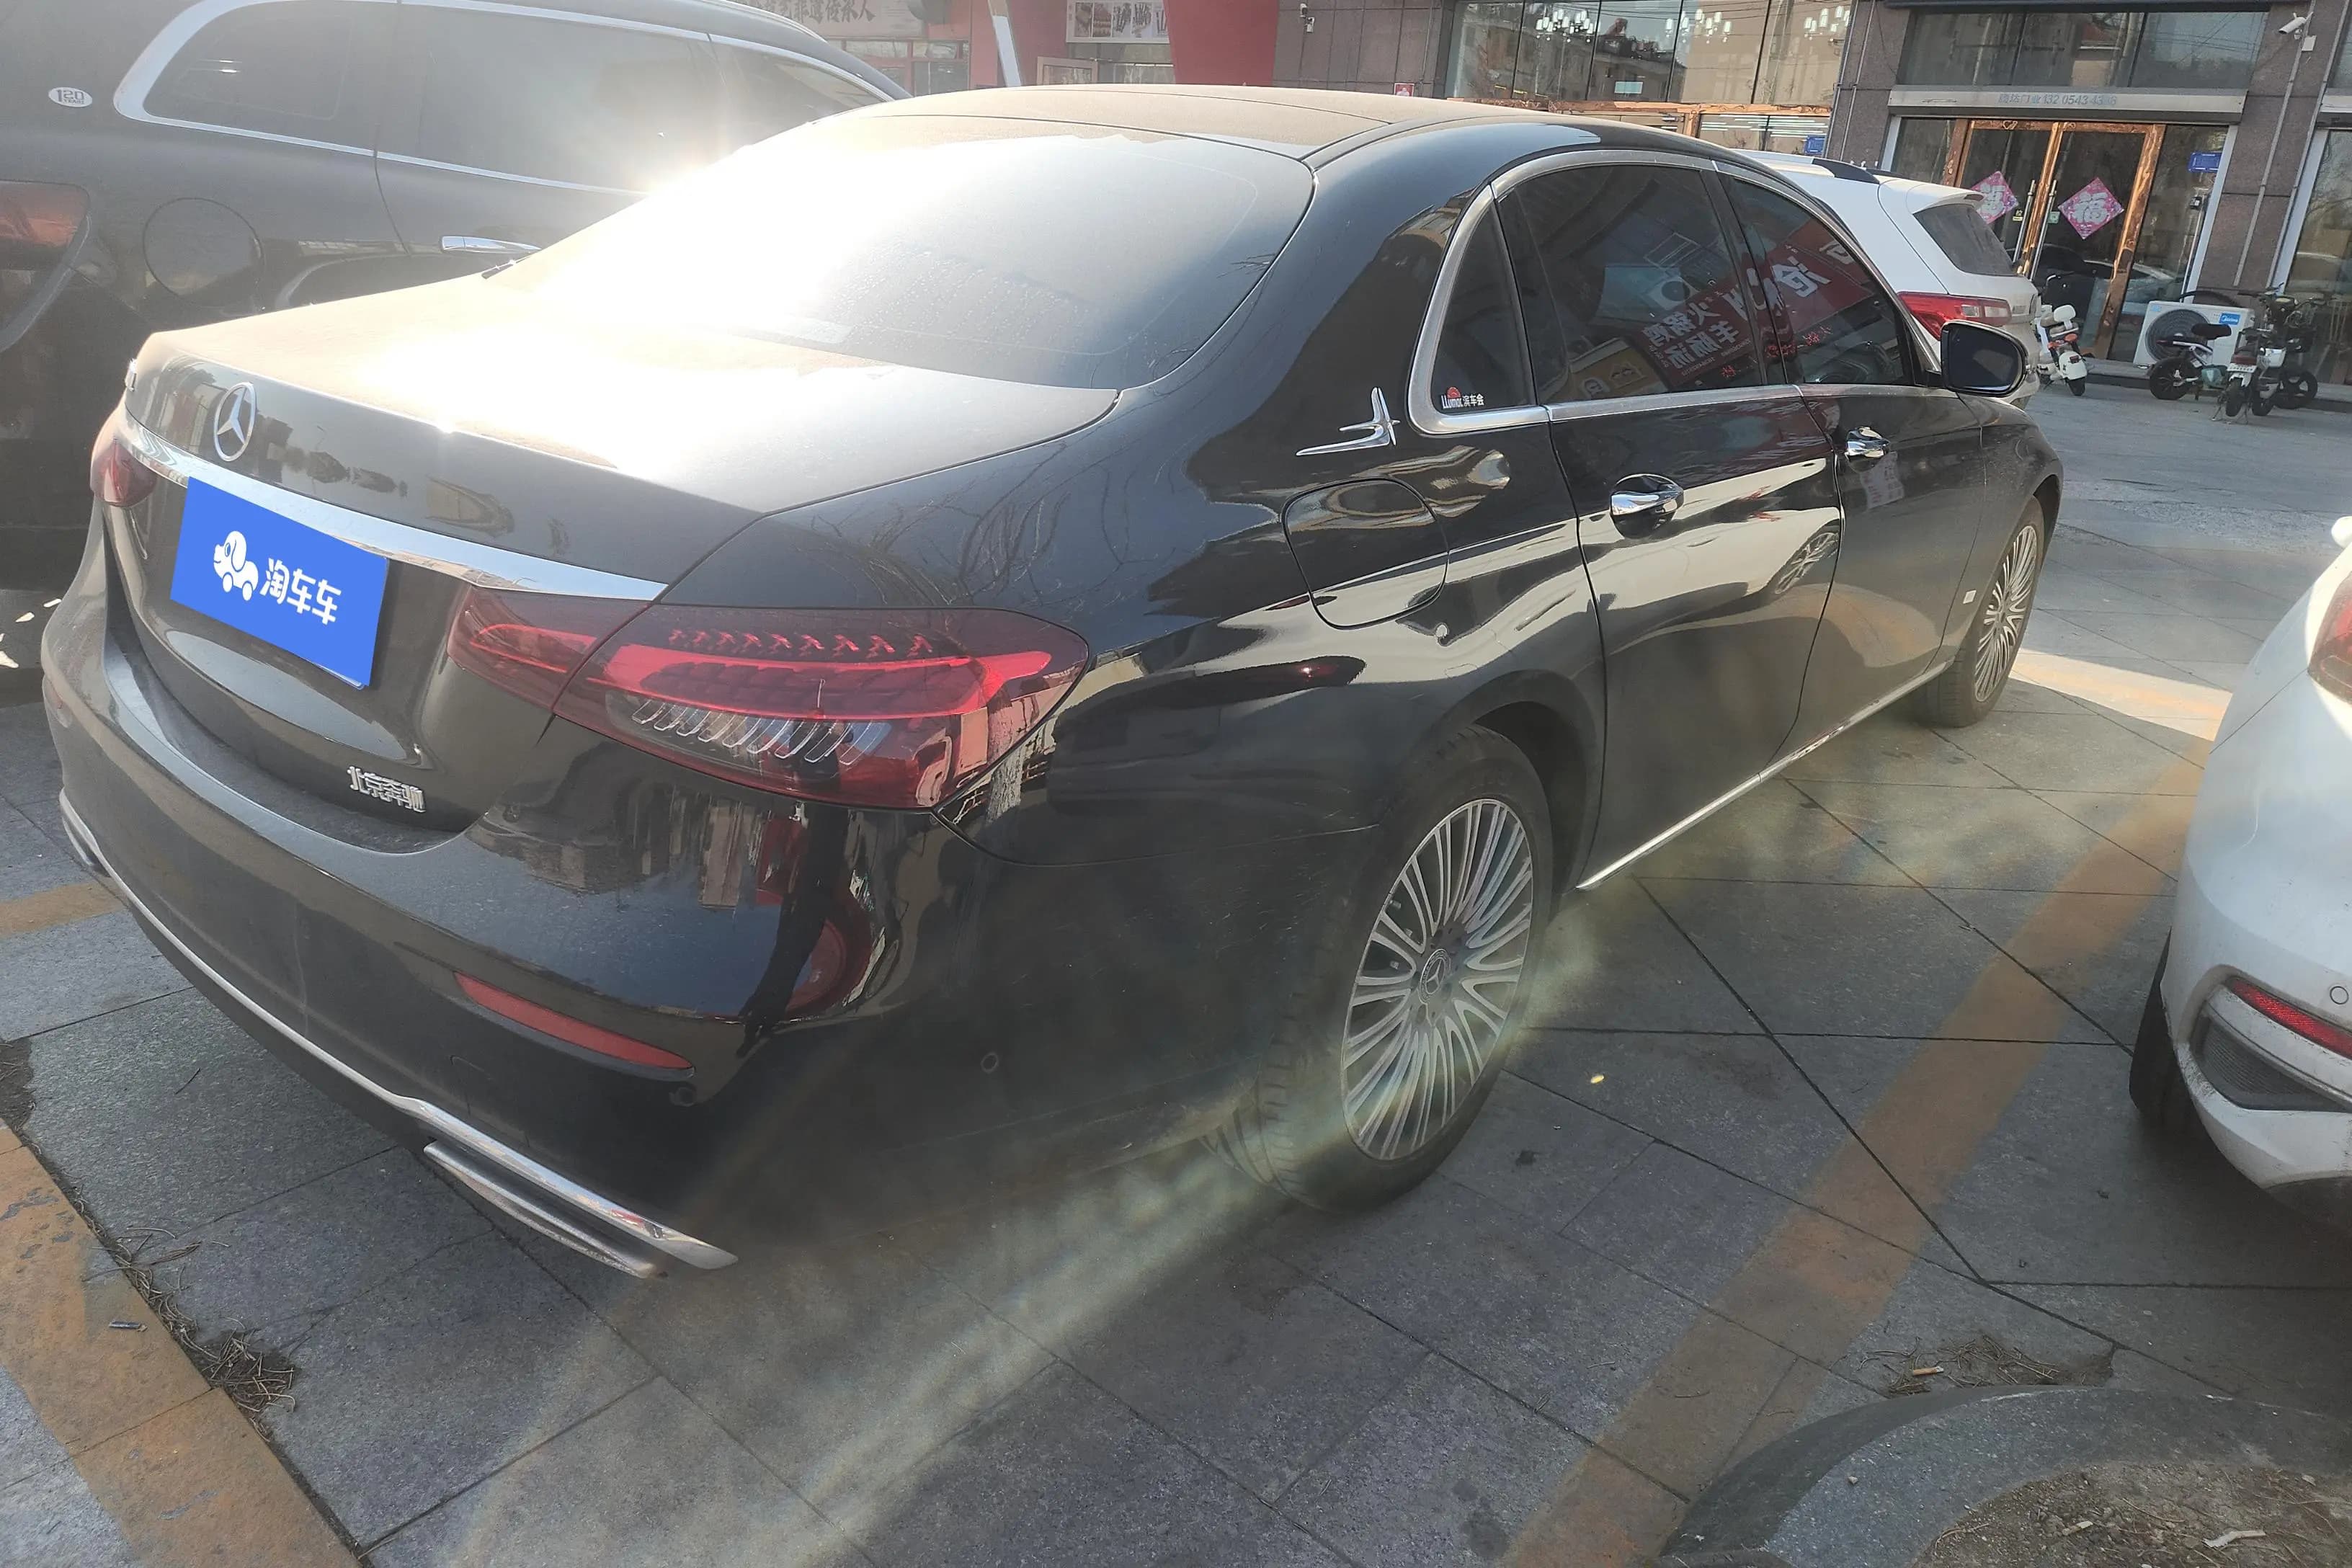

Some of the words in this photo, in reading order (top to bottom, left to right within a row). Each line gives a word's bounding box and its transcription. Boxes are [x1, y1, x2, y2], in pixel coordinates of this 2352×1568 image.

[56, 89, 84, 102] 120
[2071, 192, 2108, 224] 福
[347, 765, 427, 813] 北京奔驰
